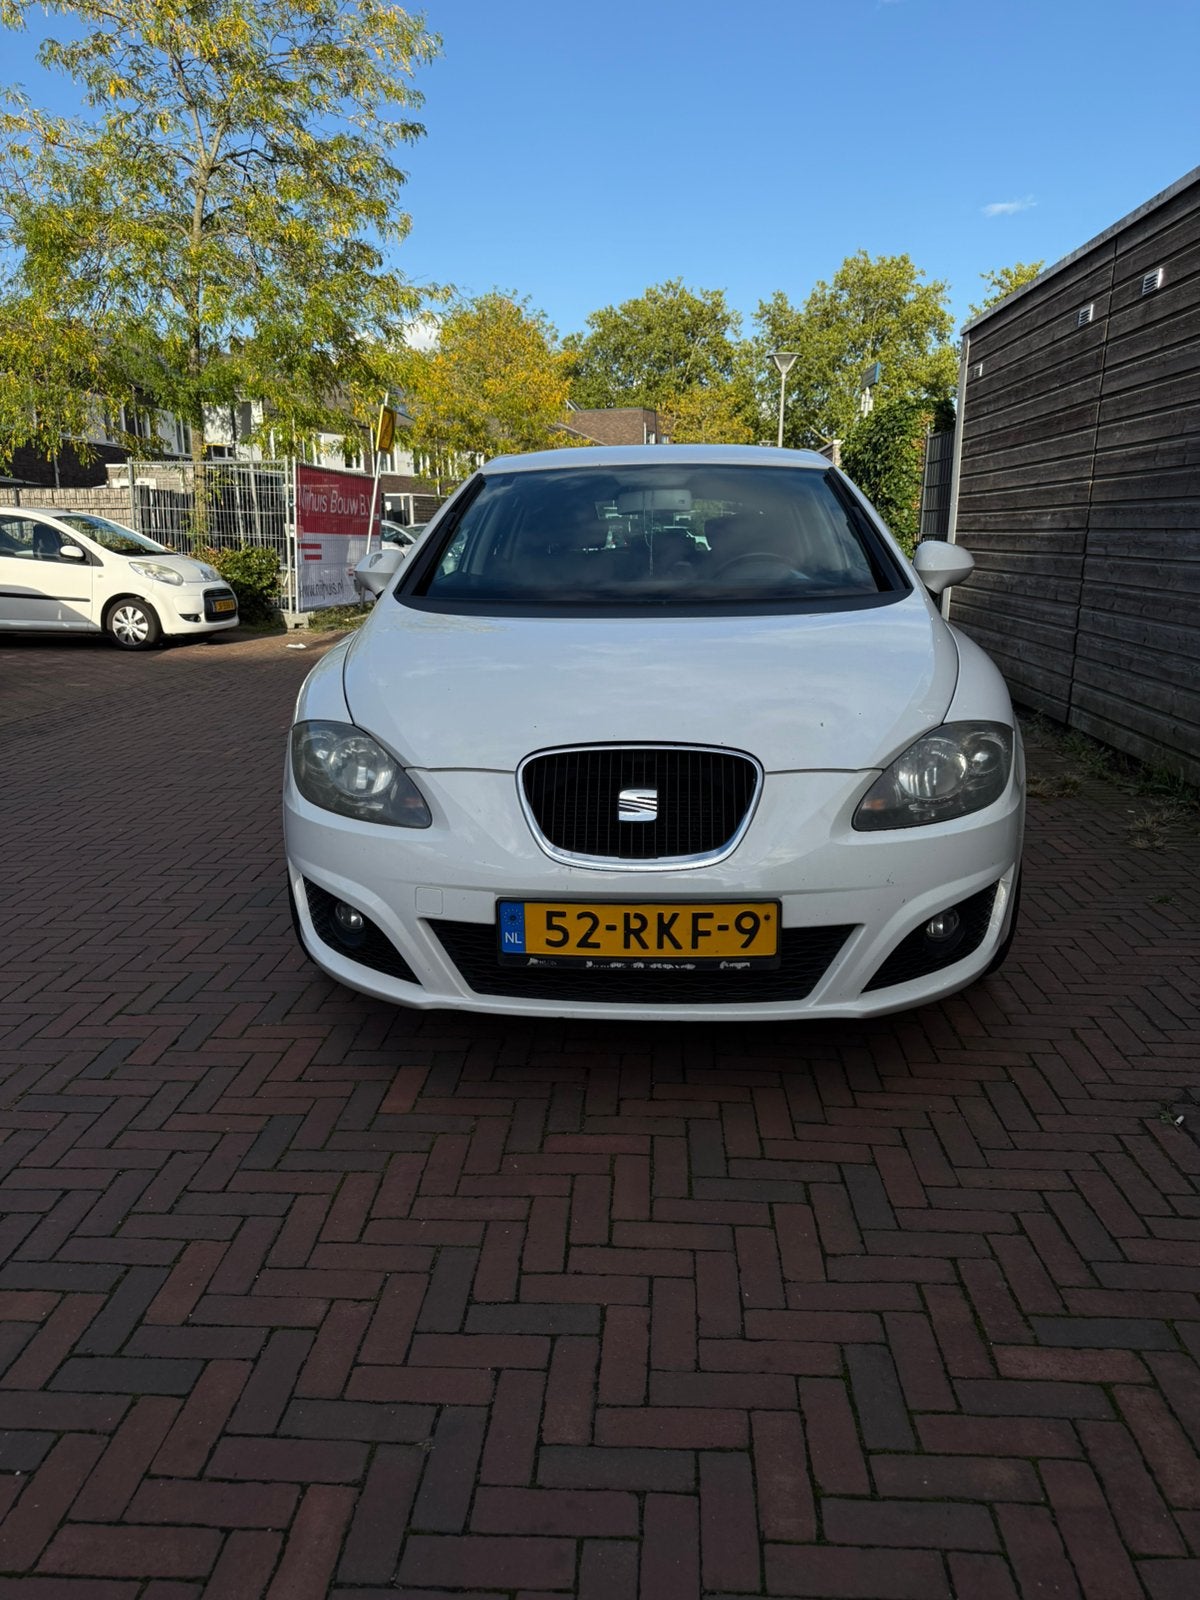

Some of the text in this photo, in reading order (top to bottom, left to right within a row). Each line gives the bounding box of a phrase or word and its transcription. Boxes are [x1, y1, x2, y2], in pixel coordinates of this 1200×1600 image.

[330, 490, 359, 516] Bouw
[505, 910, 761, 950] NL 52-RKF-9
